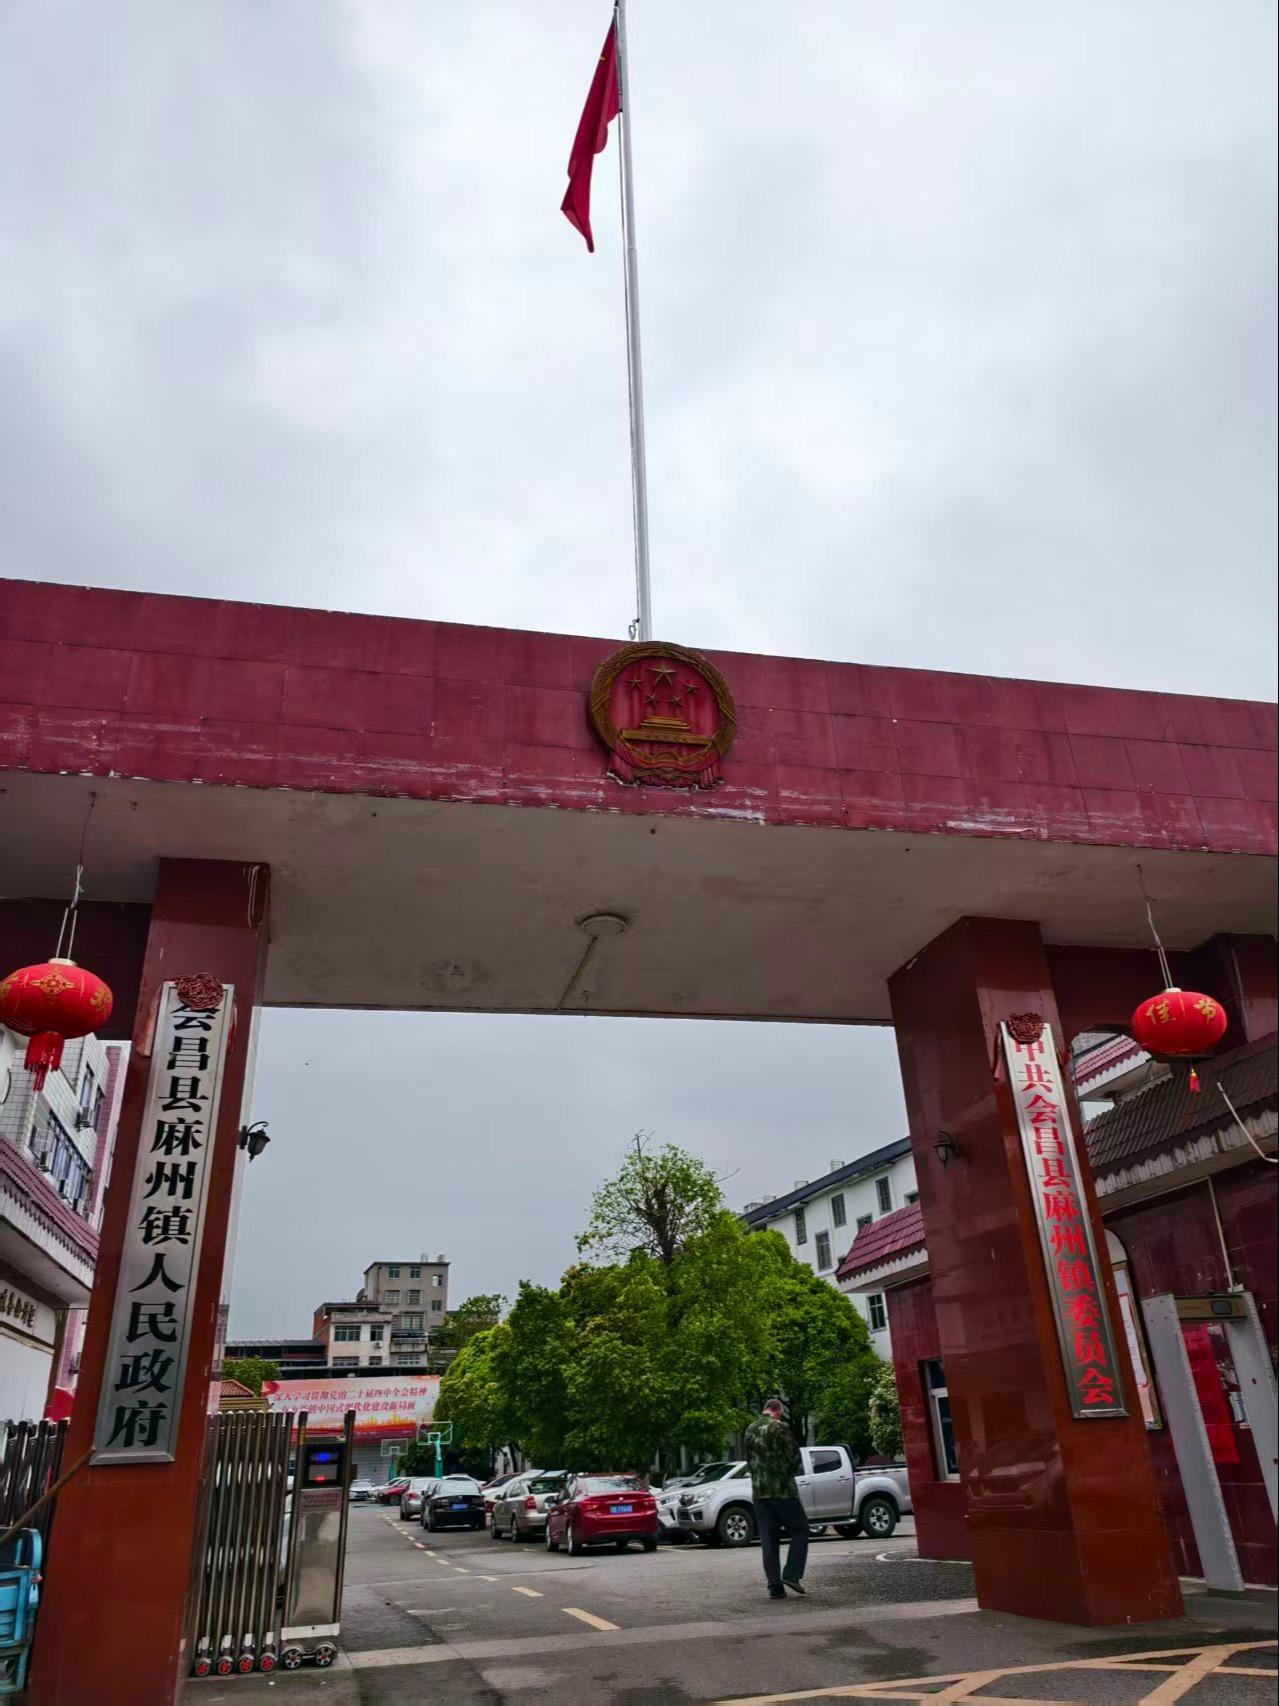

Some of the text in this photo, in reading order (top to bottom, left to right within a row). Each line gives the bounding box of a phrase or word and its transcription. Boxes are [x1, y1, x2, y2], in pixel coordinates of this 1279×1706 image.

[105, 1003, 221, 1449] 会昌县麻州镇人民政府
[1015, 1039, 1114, 1405] 中共会昌县麻州镇委员会
